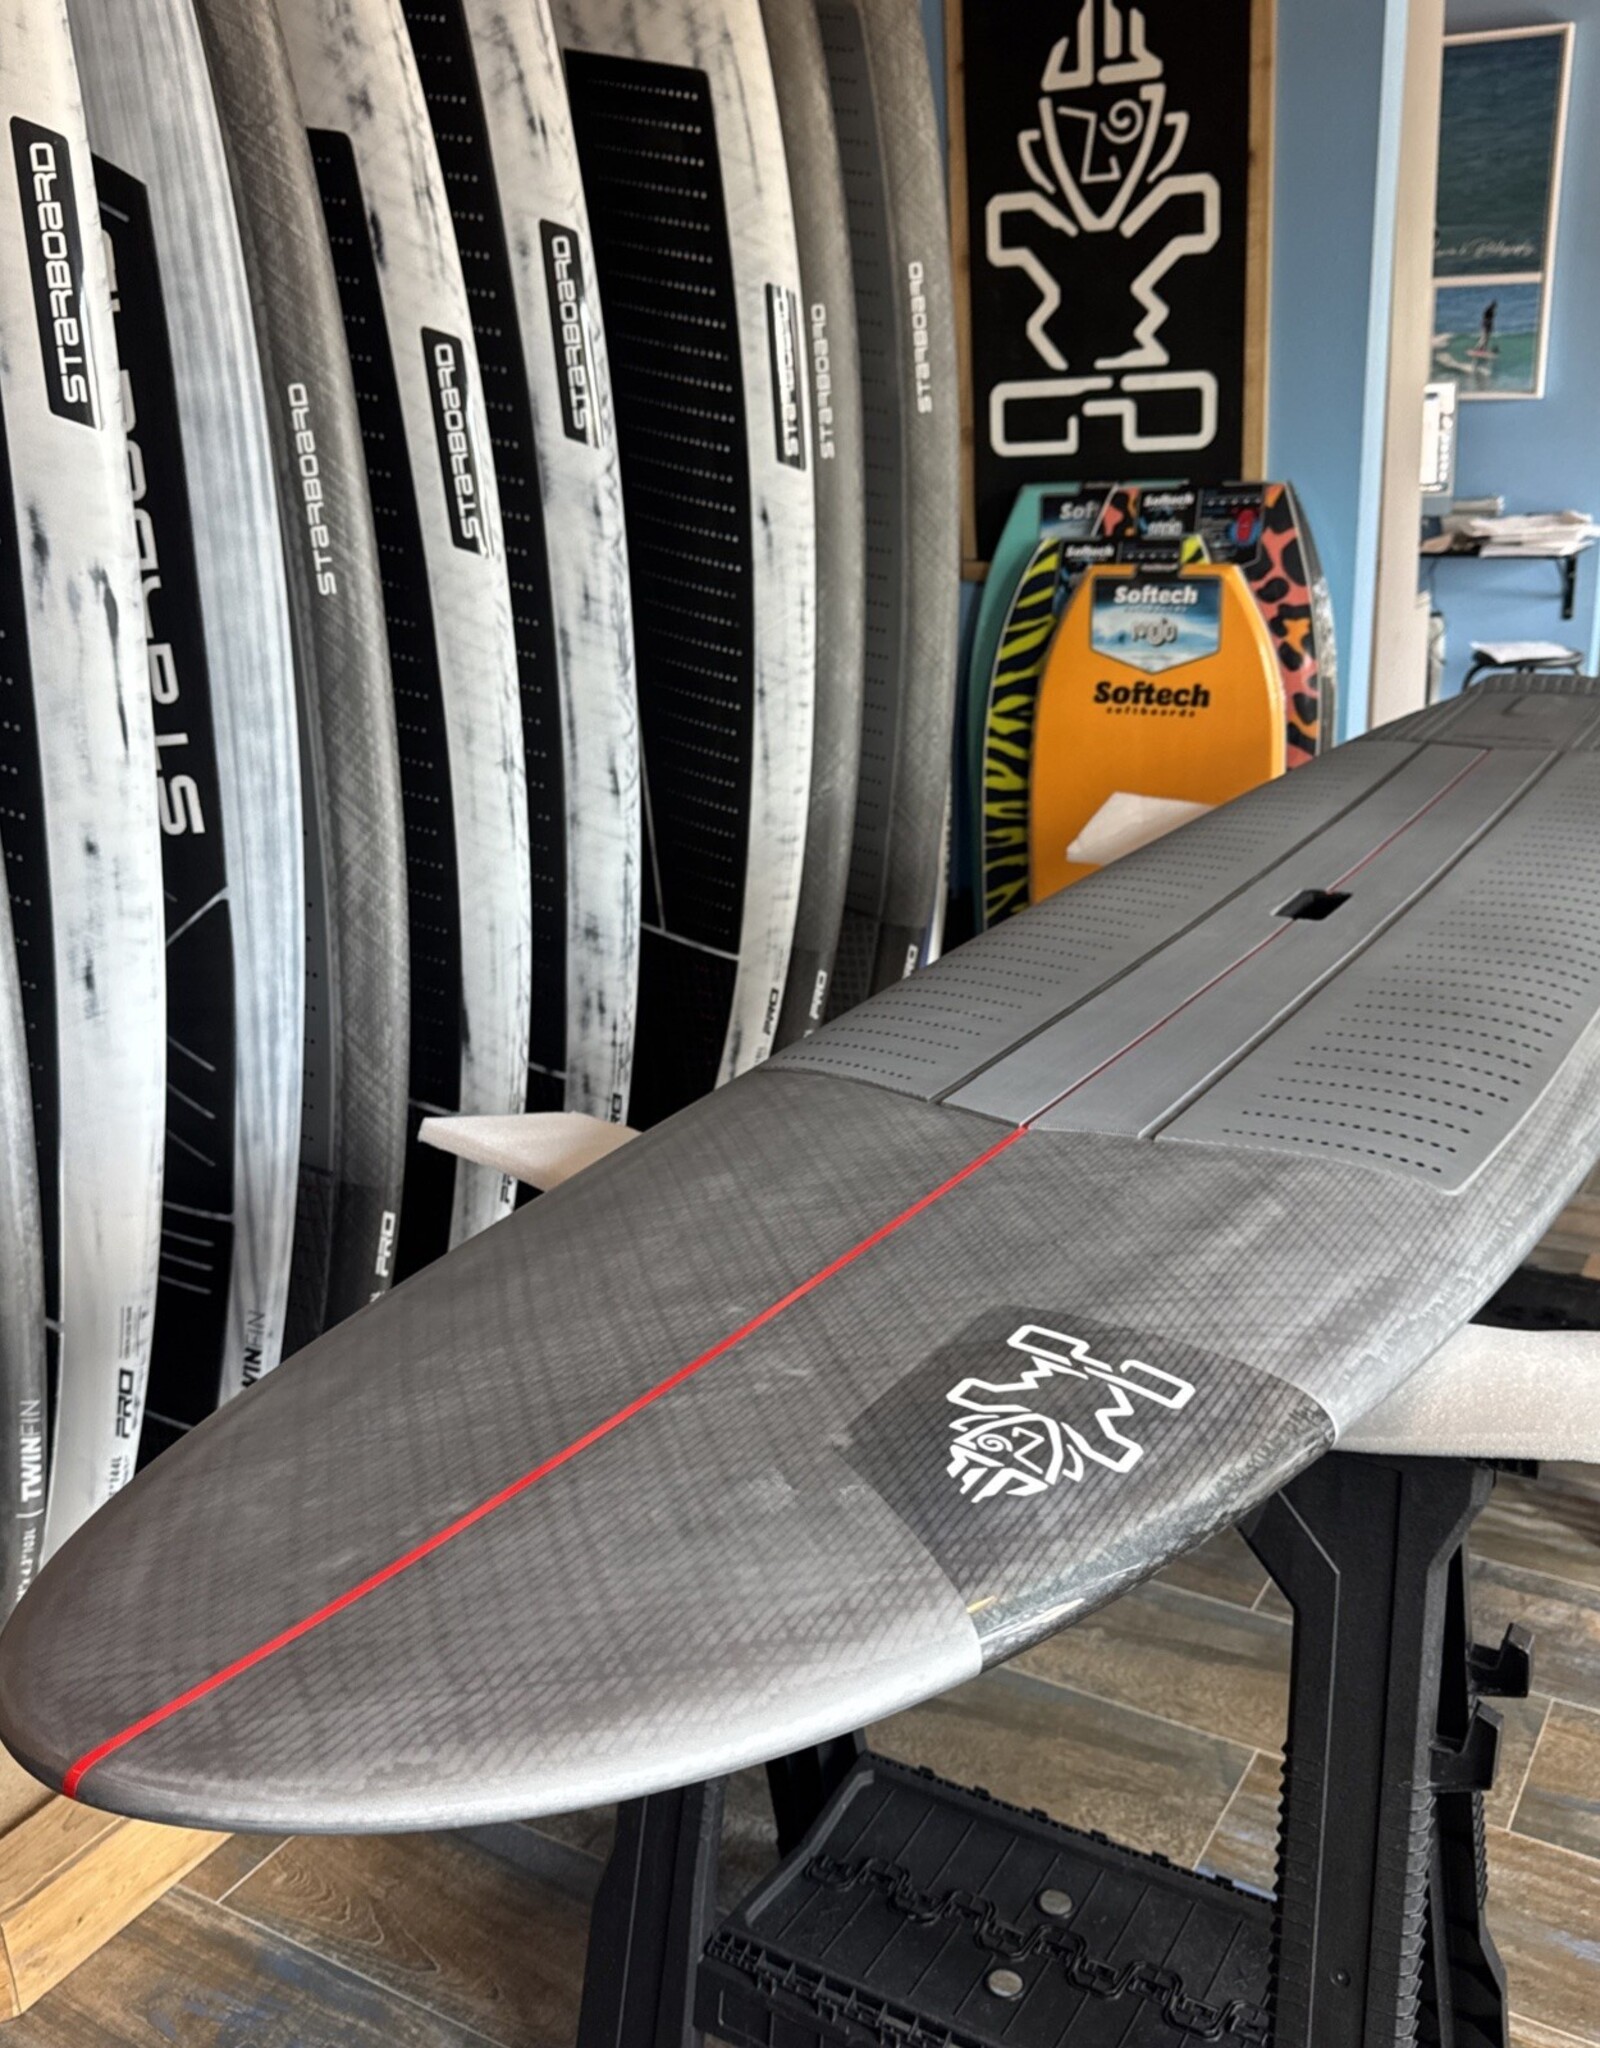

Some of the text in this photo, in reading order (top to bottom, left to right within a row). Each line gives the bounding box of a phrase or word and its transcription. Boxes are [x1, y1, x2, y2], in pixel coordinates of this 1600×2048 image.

[1114, 584, 1198, 605] Softech
[1094, 681, 1211, 709] Softech
[762, 988, 779, 1036] PRO
[809, 969, 827, 1020] PRO
[375, 1211, 396, 1276] PRO
[115, 1367, 135, 1440] PRO
[21, 1398, 43, 1503] TWINFIN
